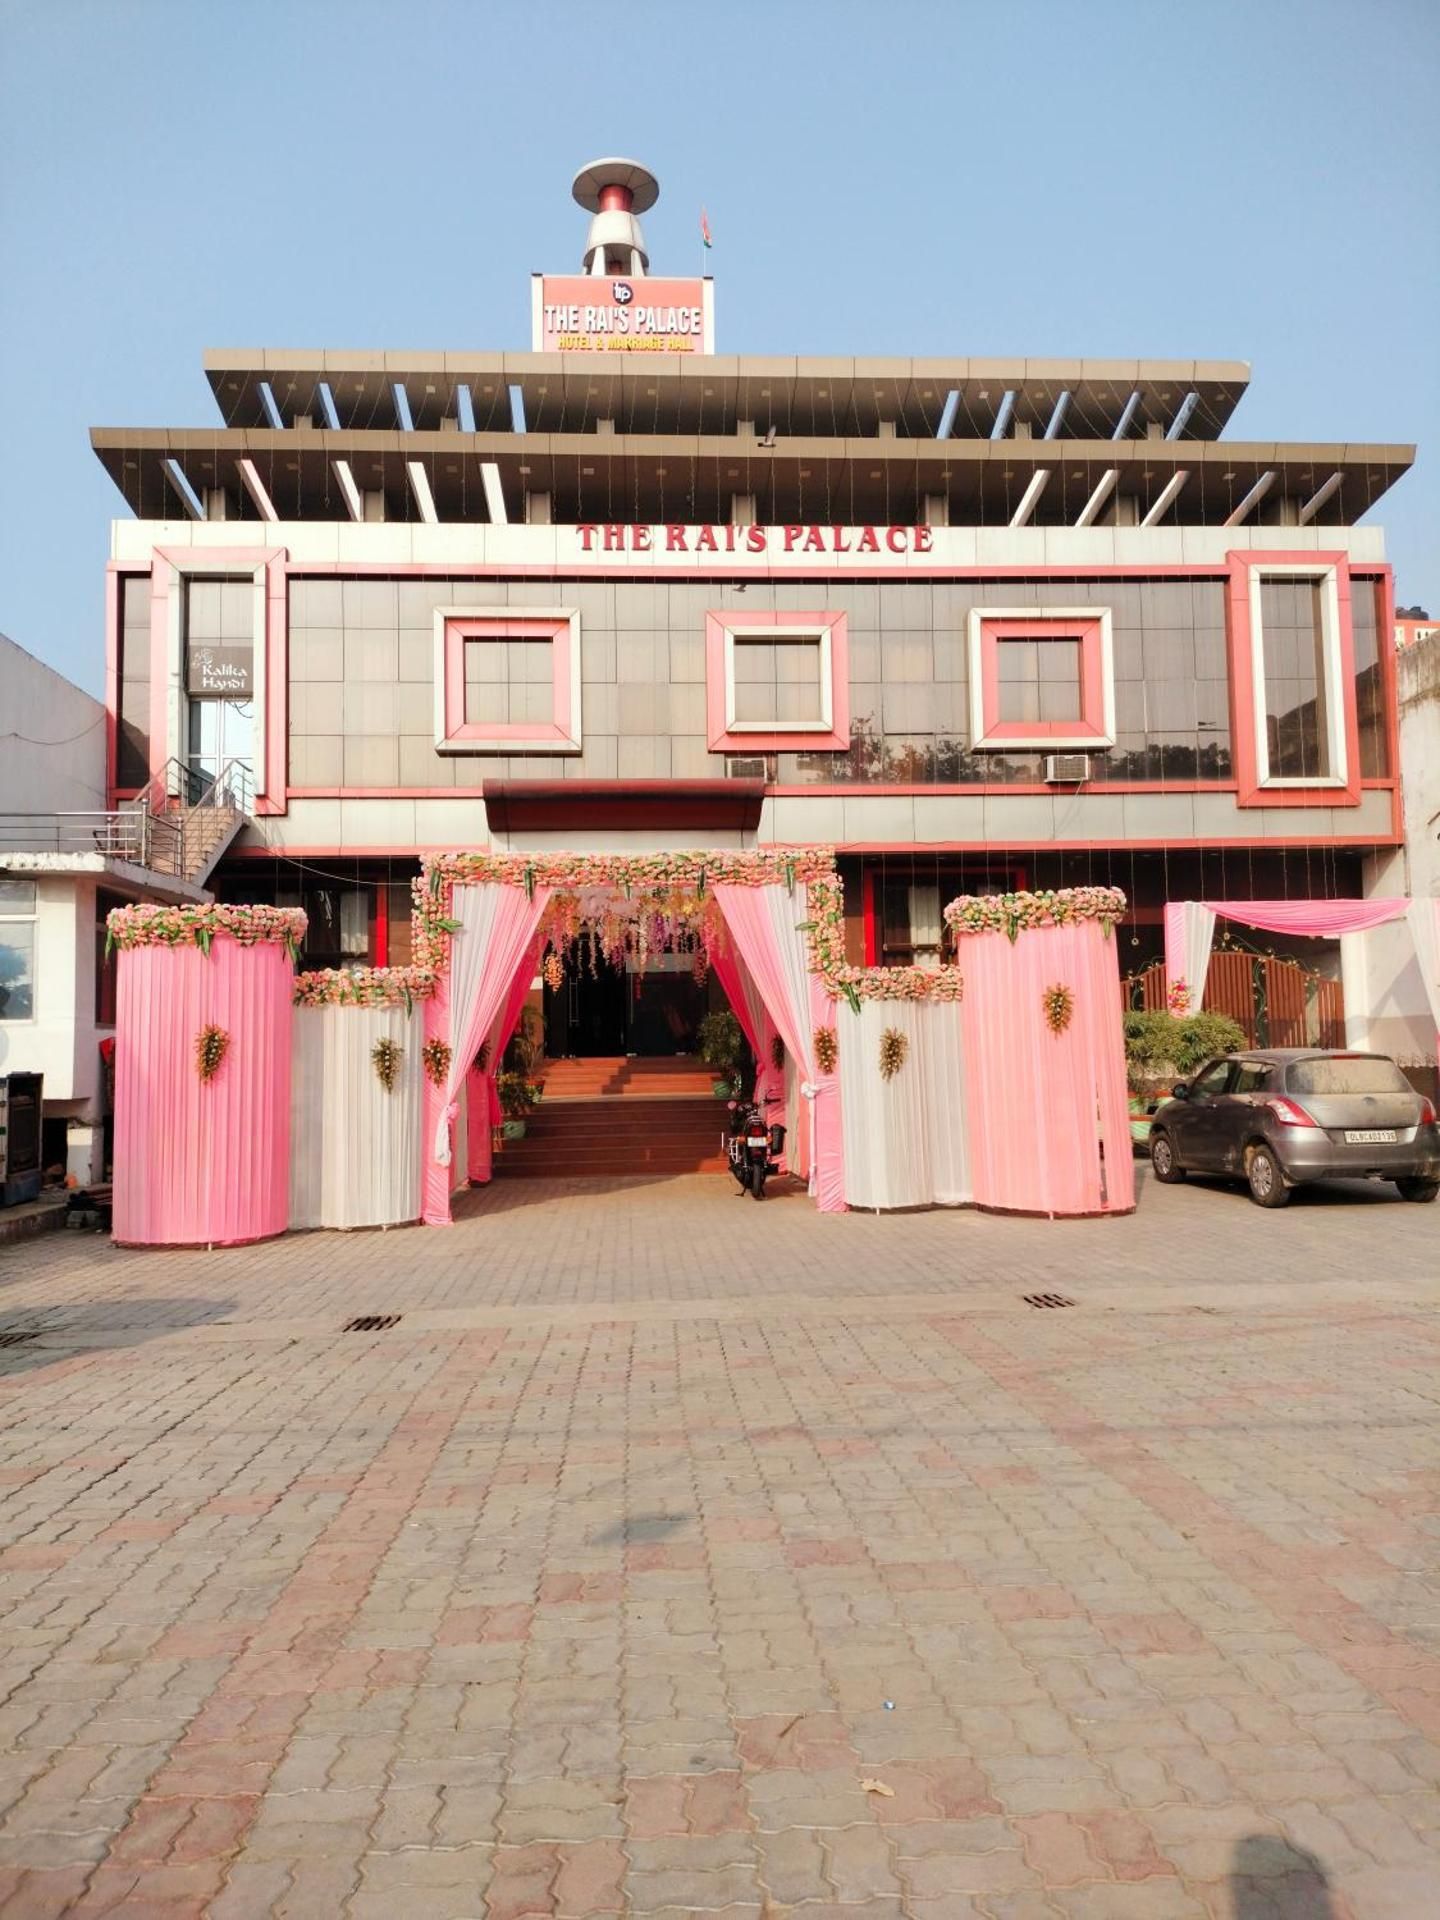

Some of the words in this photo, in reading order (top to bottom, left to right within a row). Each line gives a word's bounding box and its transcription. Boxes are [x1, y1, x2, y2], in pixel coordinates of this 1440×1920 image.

[545, 305, 579, 333] THE
[585, 306, 629, 334] RAI'S
[635, 307, 701, 335] PALACE
[558, 336, 591, 350] HOTEL
[596, 337, 604, 350] &
[608, 337, 665, 351] MARRIAGE
[668, 338, 694, 351] HALL
[576, 525, 652, 551] THE
[665, 525, 768, 552] RAI'S
[783, 525, 934, 552] PALACE
[202, 664, 248, 677] Kalika
[202, 677, 245, 690] Handi
